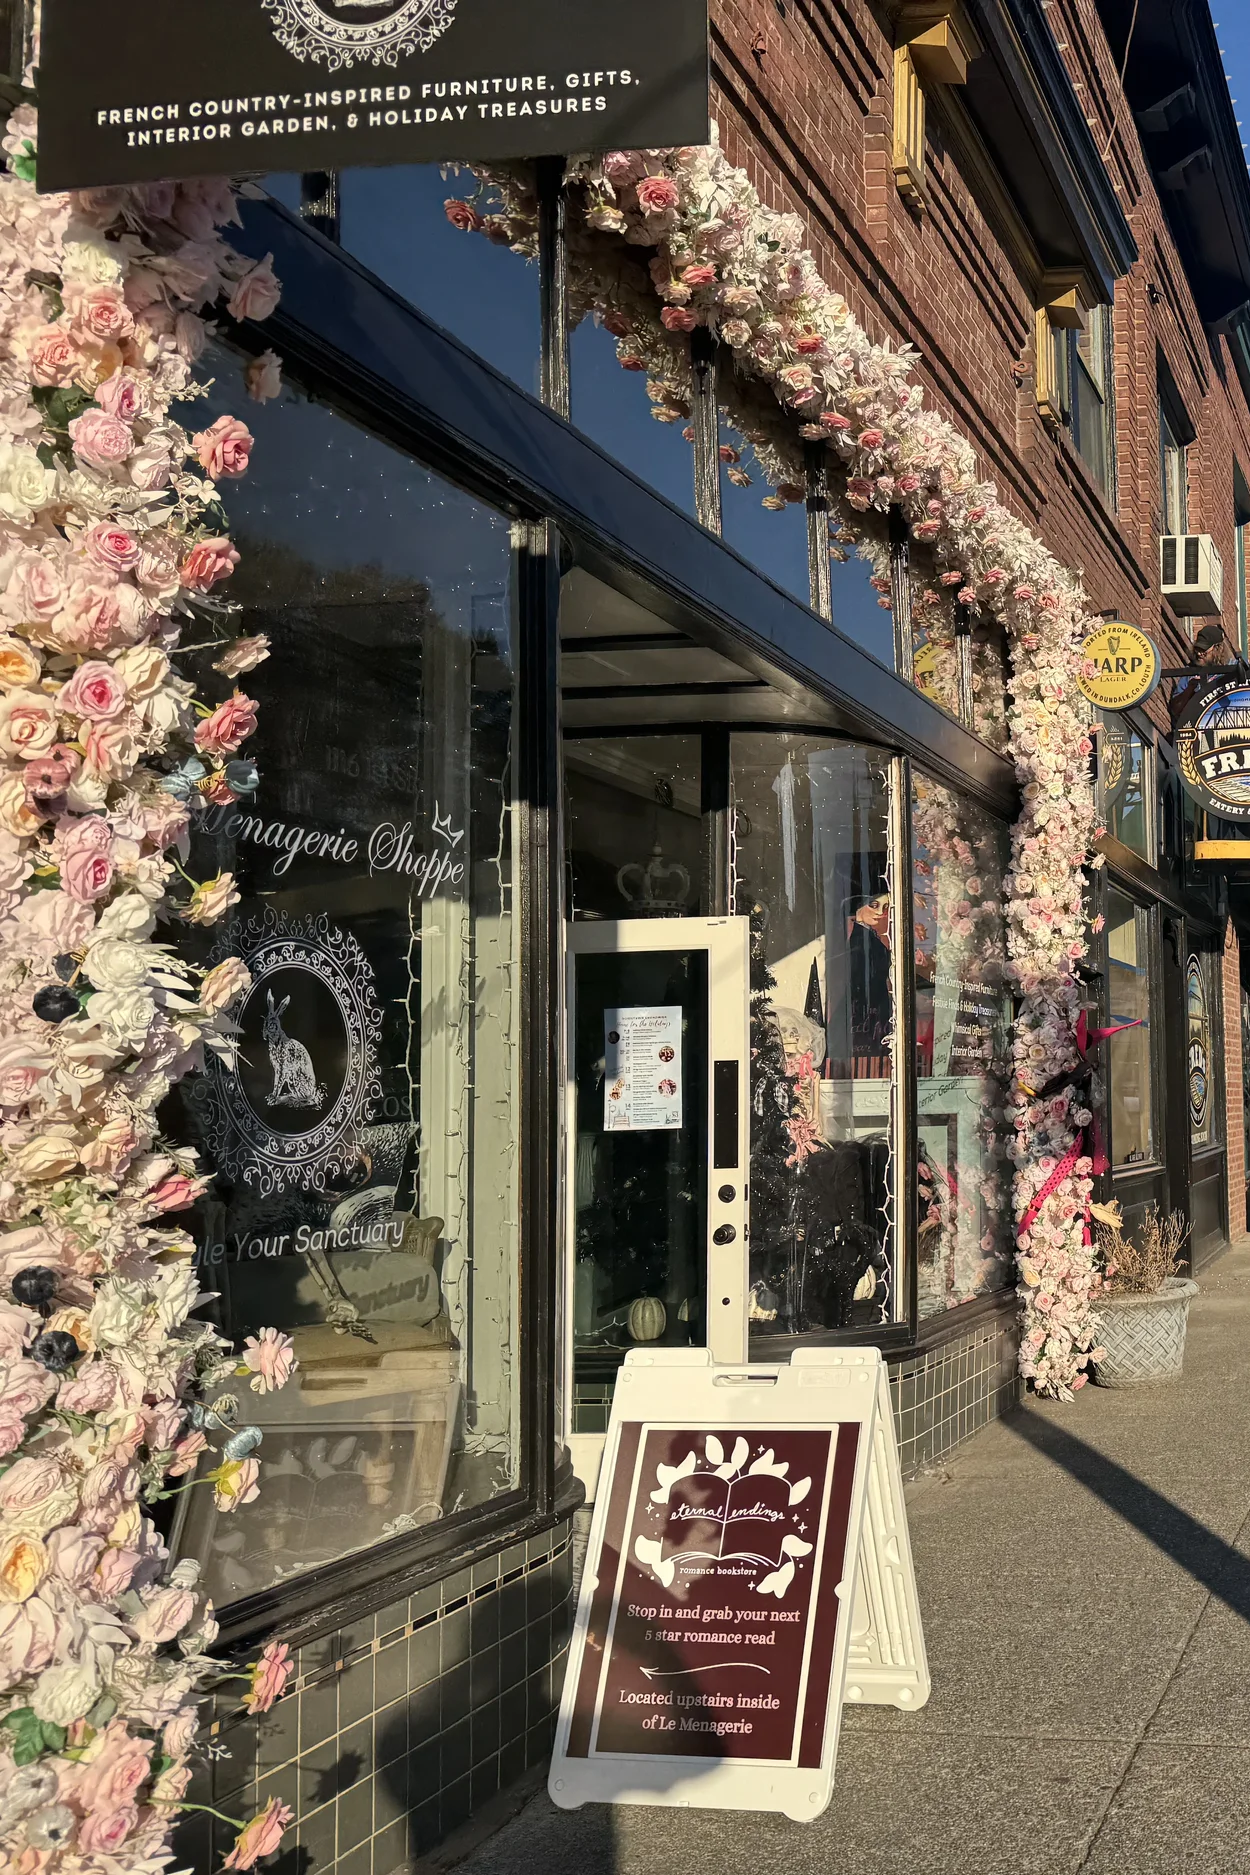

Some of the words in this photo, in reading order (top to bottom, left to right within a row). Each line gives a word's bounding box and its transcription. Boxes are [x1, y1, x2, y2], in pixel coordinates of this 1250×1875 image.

[98, 104, 179, 126] FRENCH
[189, 85, 411, 117] COUNTRY-INSPIRED
[421, 75, 555, 98] FURNITURE,
[566, 70, 640, 88] GIFTS,
[127, 124, 231, 147] INTERIOR
[241, 116, 336, 136] GARDEN,
[347, 113, 358, 128] &
[369, 105, 468, 127] HOLIDAY
[478, 96, 607, 119] TREASURES
[1083, 630, 1106, 648] ORTED
[1130, 631, 1150, 658] IRELAND
[1091, 691, 1099, 699] IN
[1139, 664, 1151, 687] LOUTH
[1200, 686, 1224, 707] FIRST
[1225, 681, 1236, 690] ST
[1209, 797, 1245, 814] EATERY
[368, 821, 464, 899] Shoppe
[930, 970, 945, 984] French
[981, 982, 998, 997] Furniture
[963, 1000, 979, 1017] Holiday
[972, 1024, 982, 1039] Gifts
[951, 1044, 967, 1056] Interior
[968, 1045, 983, 1058] Garden
[234, 1232, 289, 1262] Your
[294, 1220, 404, 1253] Sanctuary
[669, 1502, 723, 1520] eternal
[728, 1501, 785, 1522] endings
[680, 1566, 715, 1575] romance
[717, 1565, 757, 1575] bookstore
[627, 1604, 657, 1620] Stop
[658, 1604, 672, 1619] in
[675, 1604, 700, 1619] and
[702, 1605, 733, 1623] grab
[734, 1610, 767, 1624] your
[769, 1609, 800, 1622] next
[644, 1630, 652, 1641] 5
[655, 1629, 681, 1642] star
[683, 1632, 742, 1644] romance
[744, 1630, 776, 1645] read
[618, 1689, 673, 1706] Located
[676, 1692, 734, 1709] upstairs
[736, 1693, 780, 1710] inside
[642, 1714, 658, 1730] of
[659, 1715, 676, 1730] Le
[678, 1716, 753, 1737] Menagerie
